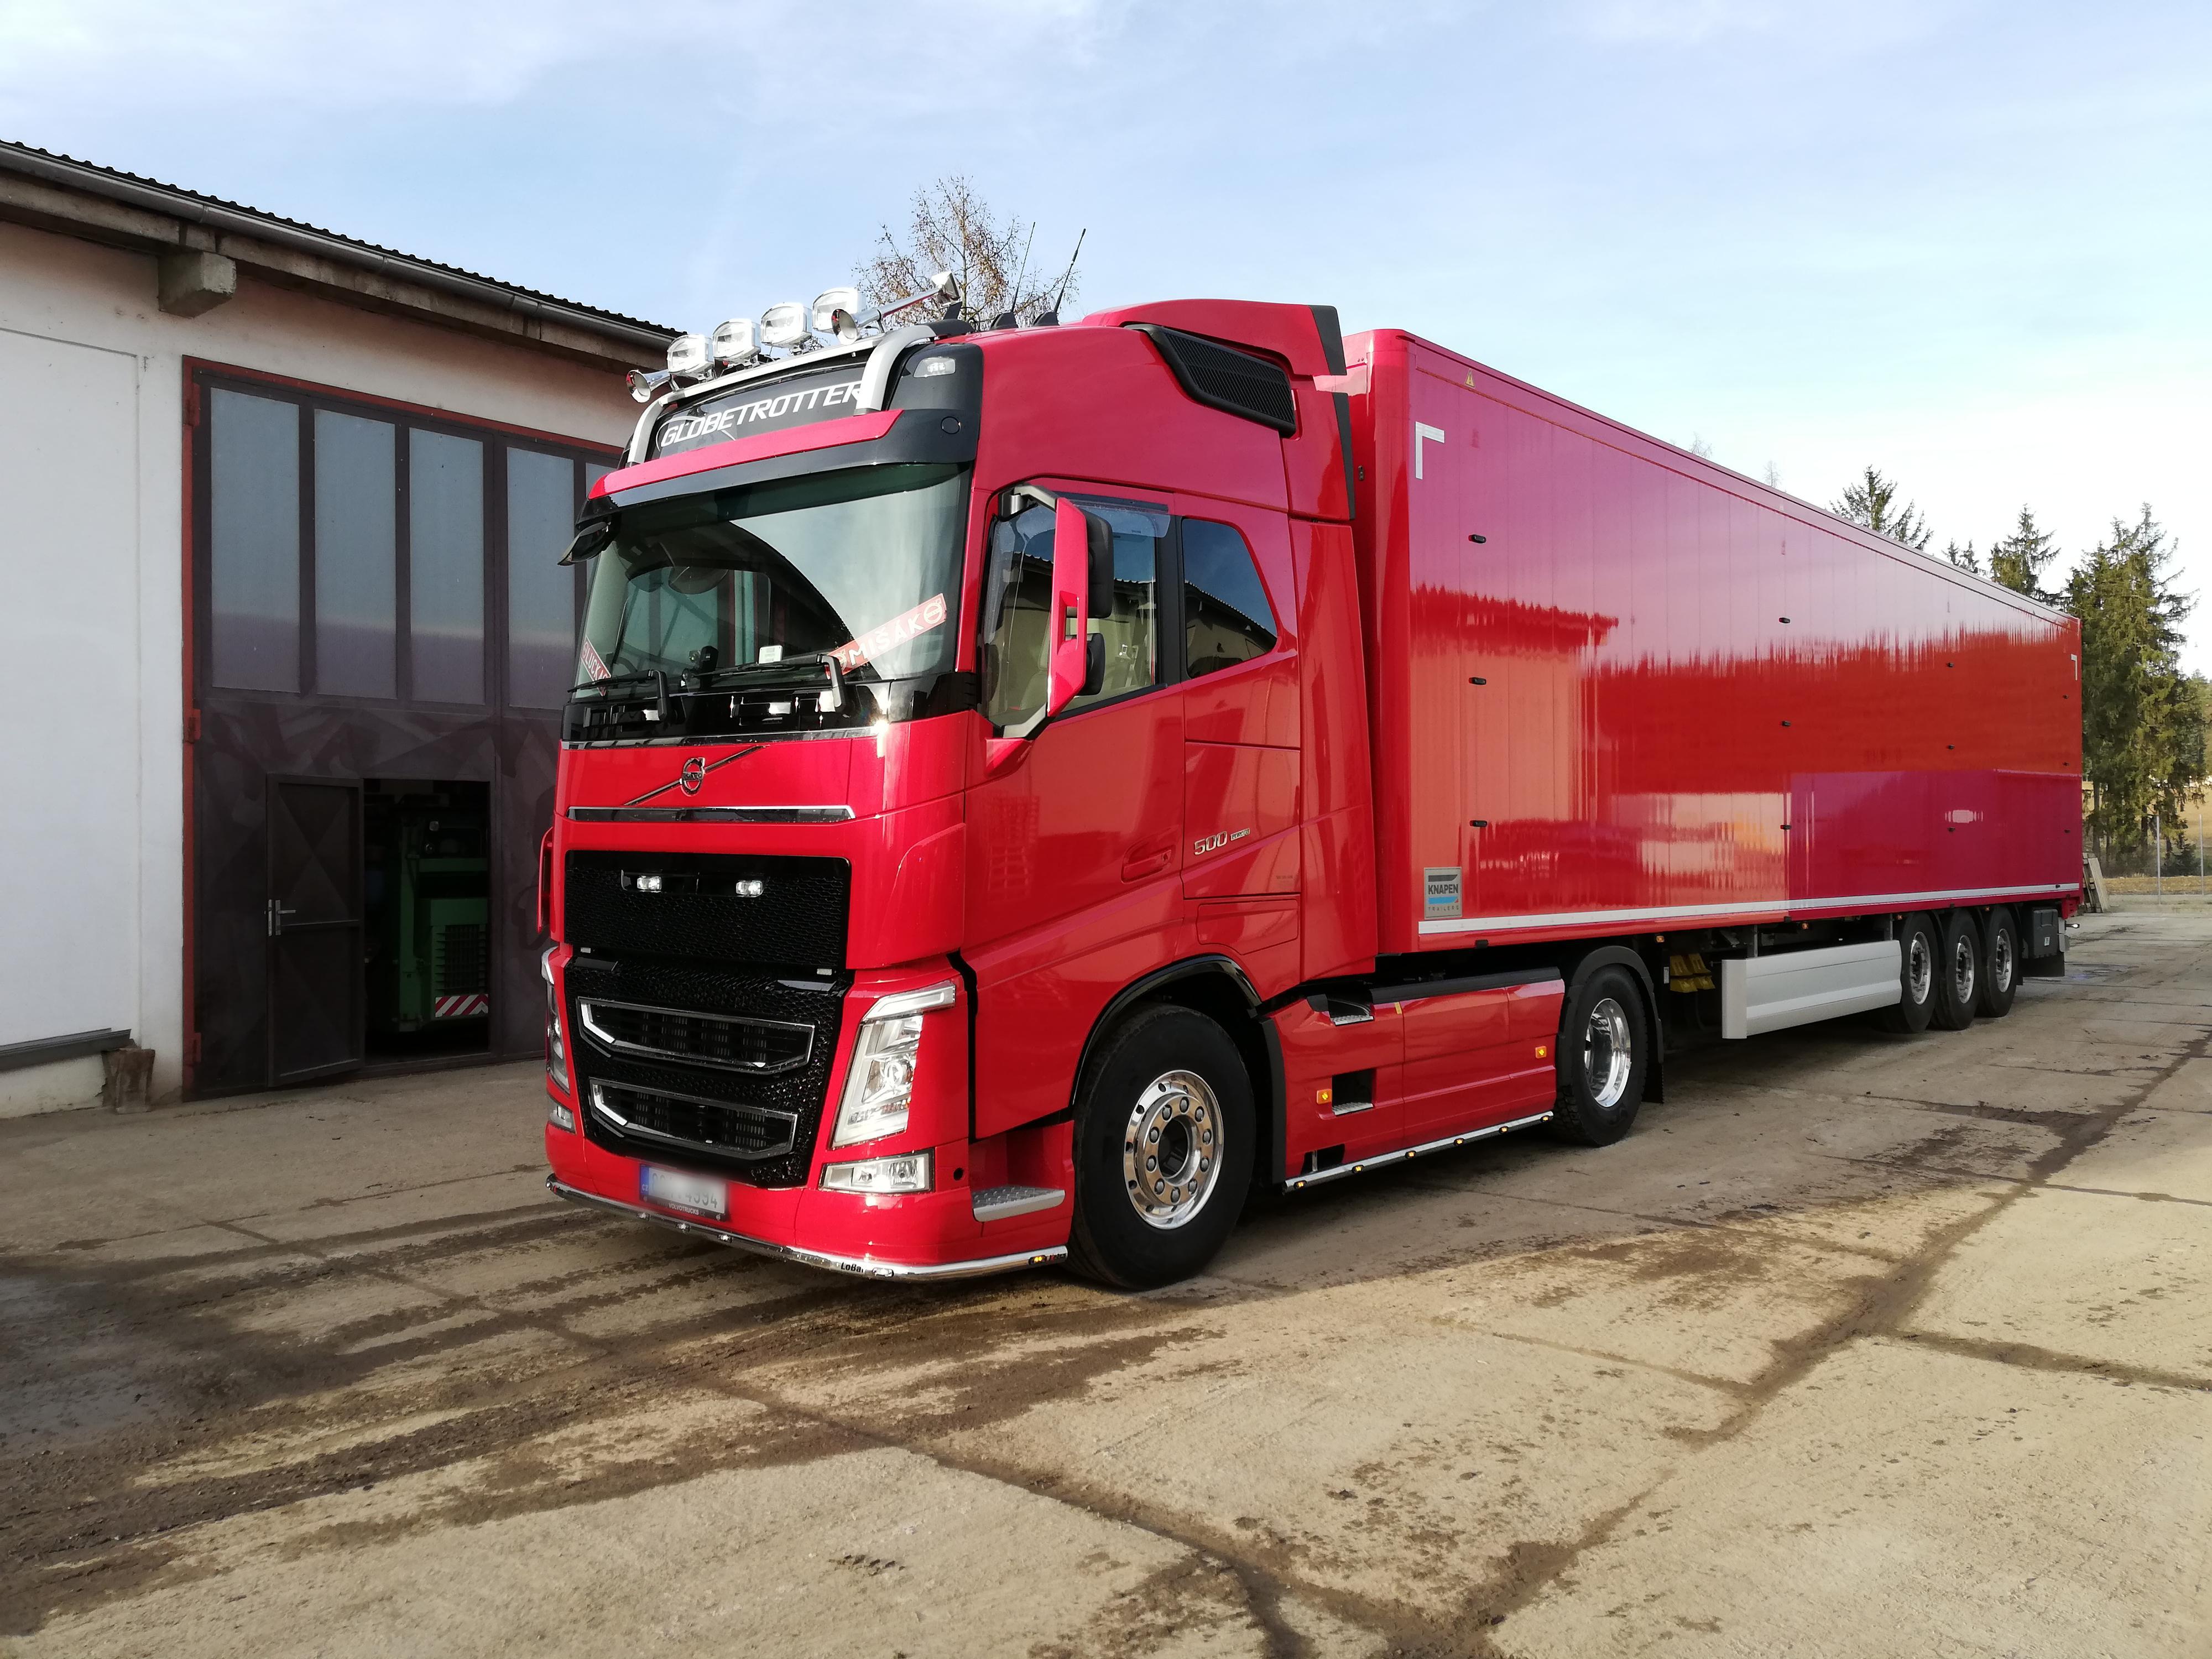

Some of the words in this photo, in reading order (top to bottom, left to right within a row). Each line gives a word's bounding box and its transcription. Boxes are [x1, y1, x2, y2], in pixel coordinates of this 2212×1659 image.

[660, 380, 862, 447] GLOBETROTTER
[848, 613, 925, 666] MIŠÁK
[1194, 831, 1228, 855] 500
[1428, 884, 1459, 895] KNAPEN
[641, 1183, 648, 1192] CZ
